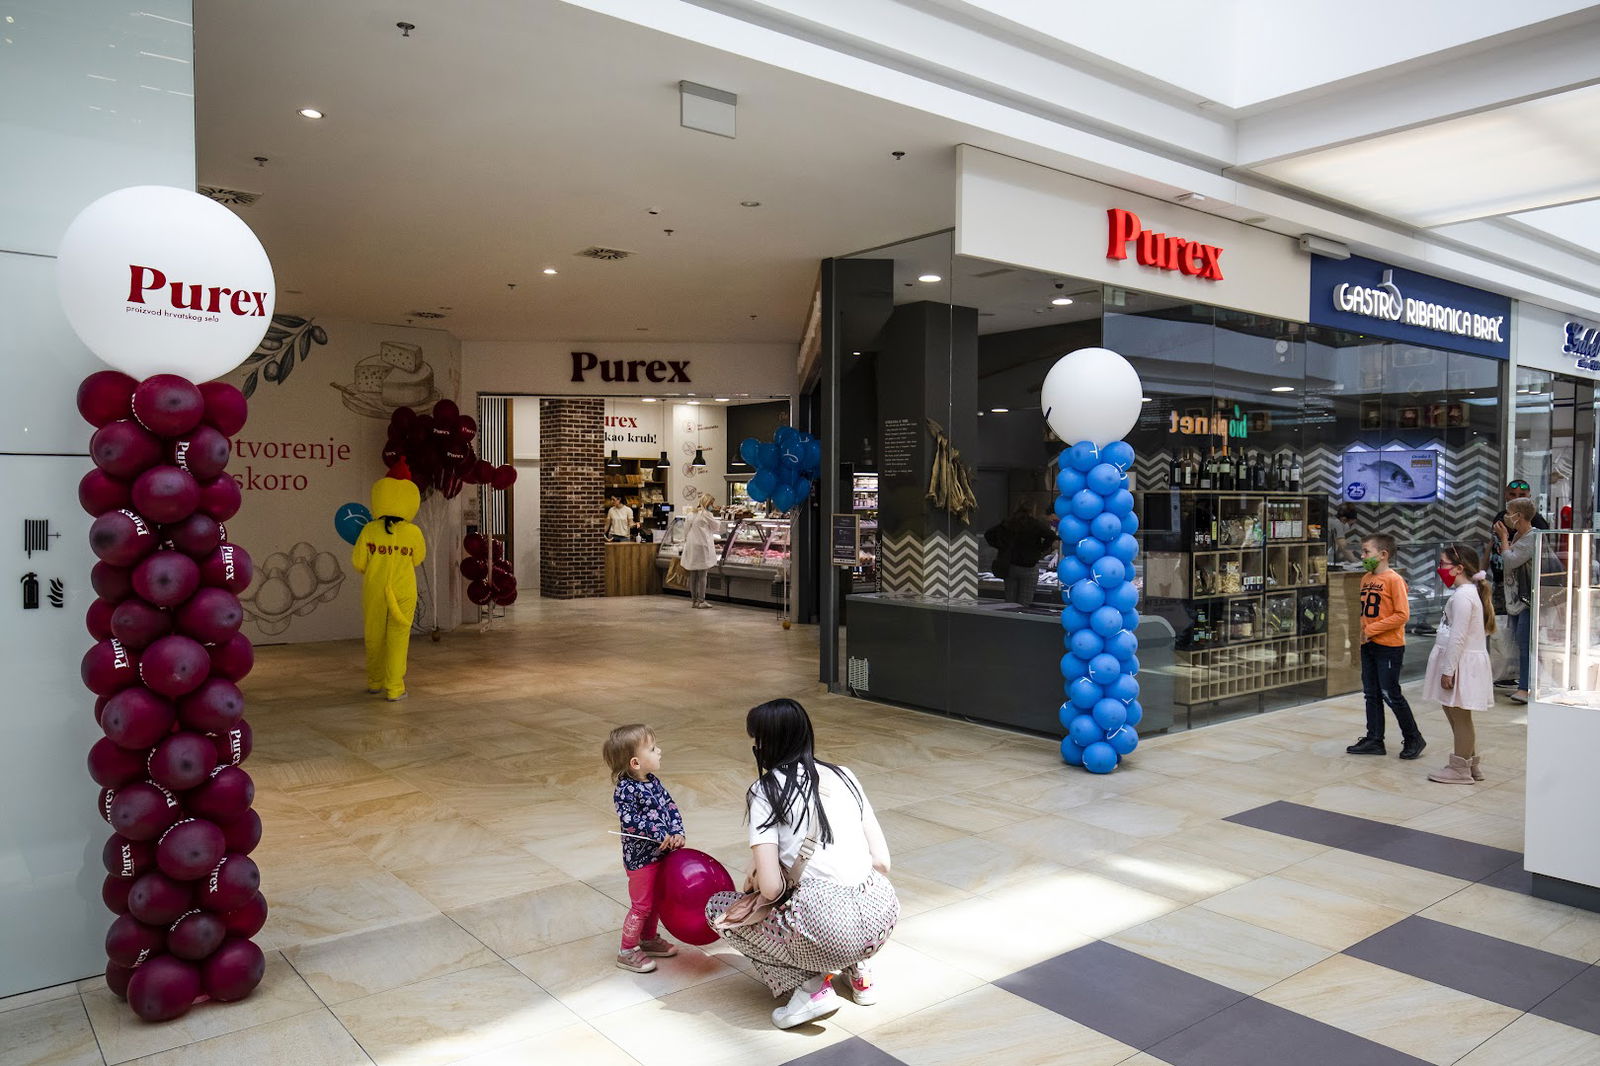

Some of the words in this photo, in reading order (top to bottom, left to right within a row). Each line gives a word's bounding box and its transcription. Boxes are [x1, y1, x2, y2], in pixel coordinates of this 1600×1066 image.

[1106, 208, 1224, 280] Purex
[127, 264, 268, 317] Purex
[125, 306, 162, 317] proizvod
[164, 309, 202, 322] hrvatskog
[1334, 282, 1403, 321] GASTRO
[1406, 298, 1471, 336] RIBARNICA
[1474, 313, 1504, 342] BRAČ
[571, 352, 692, 382] Purex
[604, 415, 637, 428] rex
[228, 437, 351, 468] tvorenje
[604, 432, 624, 442] kao
[628, 433, 657, 444] kruh!
[233, 466, 308, 491] skoro
[222, 546, 234, 580] Purex
[121, 844, 132, 876] Purex
